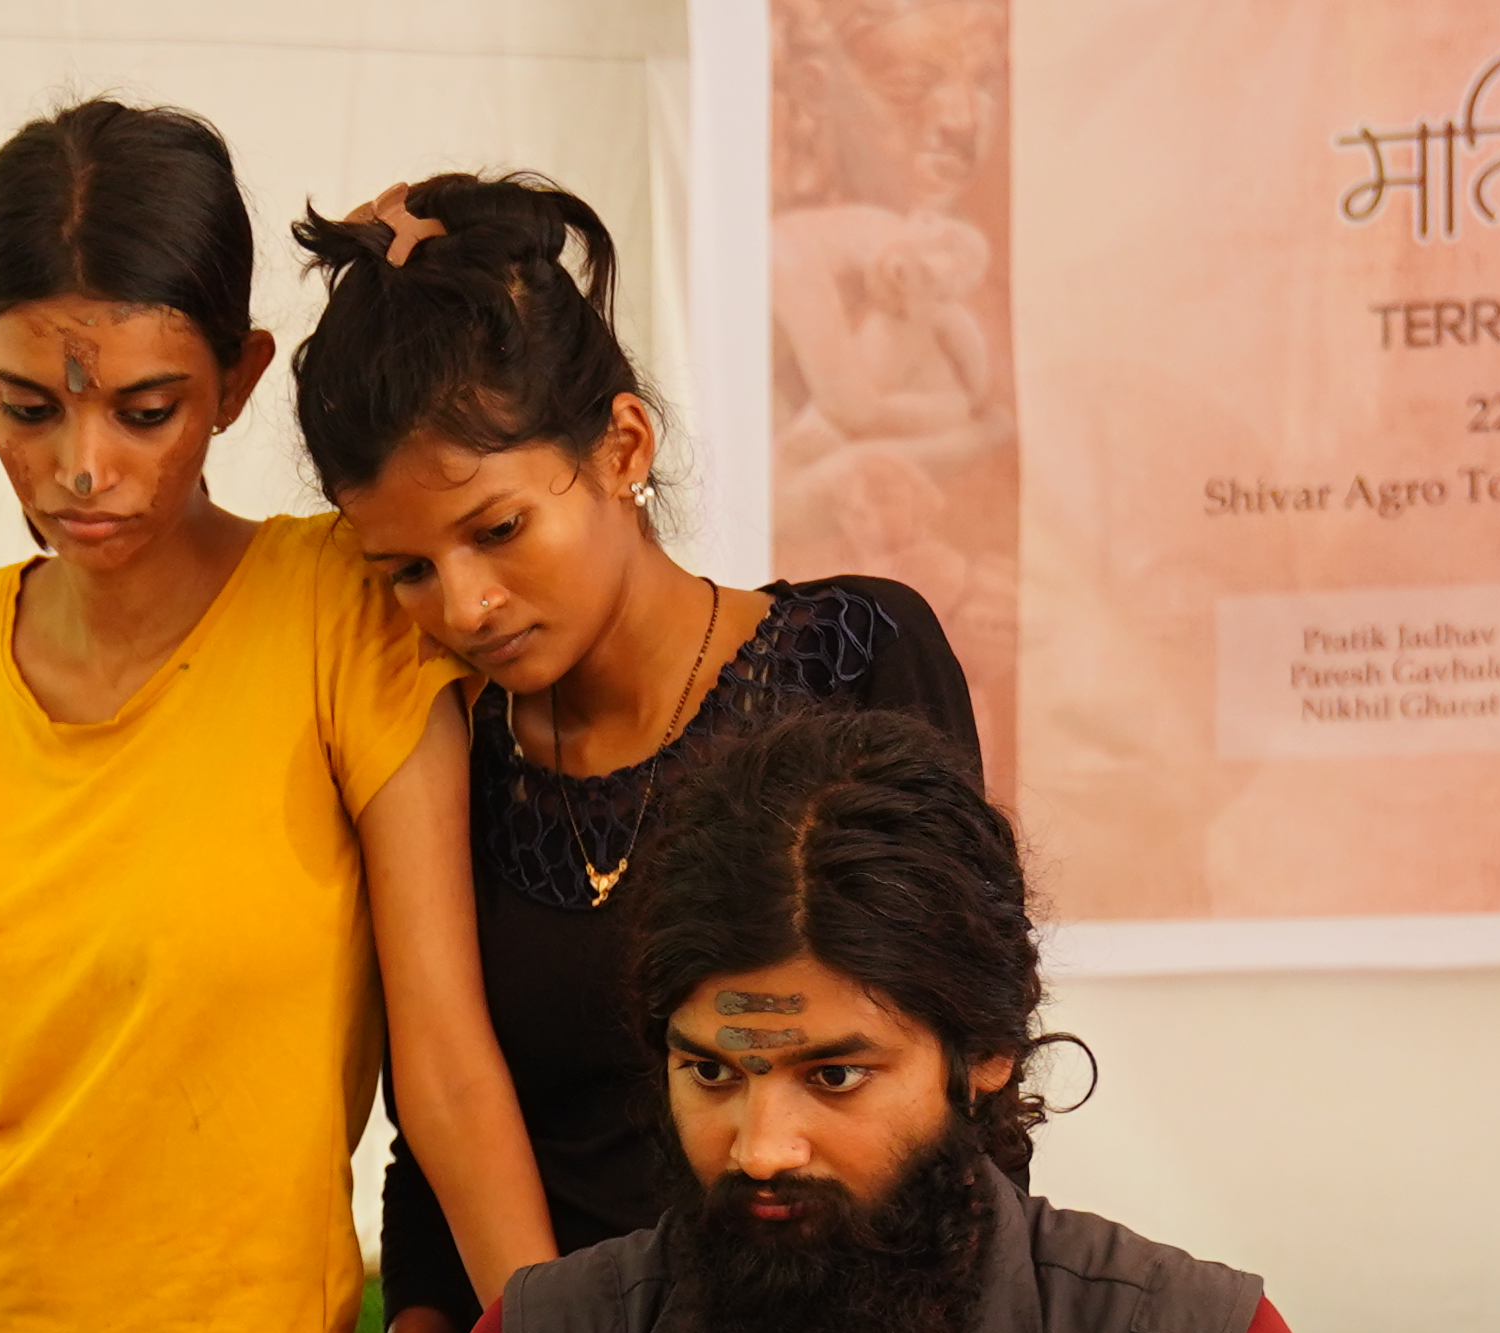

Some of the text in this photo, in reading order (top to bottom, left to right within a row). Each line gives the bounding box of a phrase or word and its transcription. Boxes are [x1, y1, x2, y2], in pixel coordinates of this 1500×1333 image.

[1203, 475, 1332, 518] Shivar
[1344, 473, 1448, 519] Agro
[1302, 622, 1497, 654] Pratik Jadhav
[1290, 659, 1382, 689] Paresh
[1301, 692, 1500, 723] Nikhil Gharat
